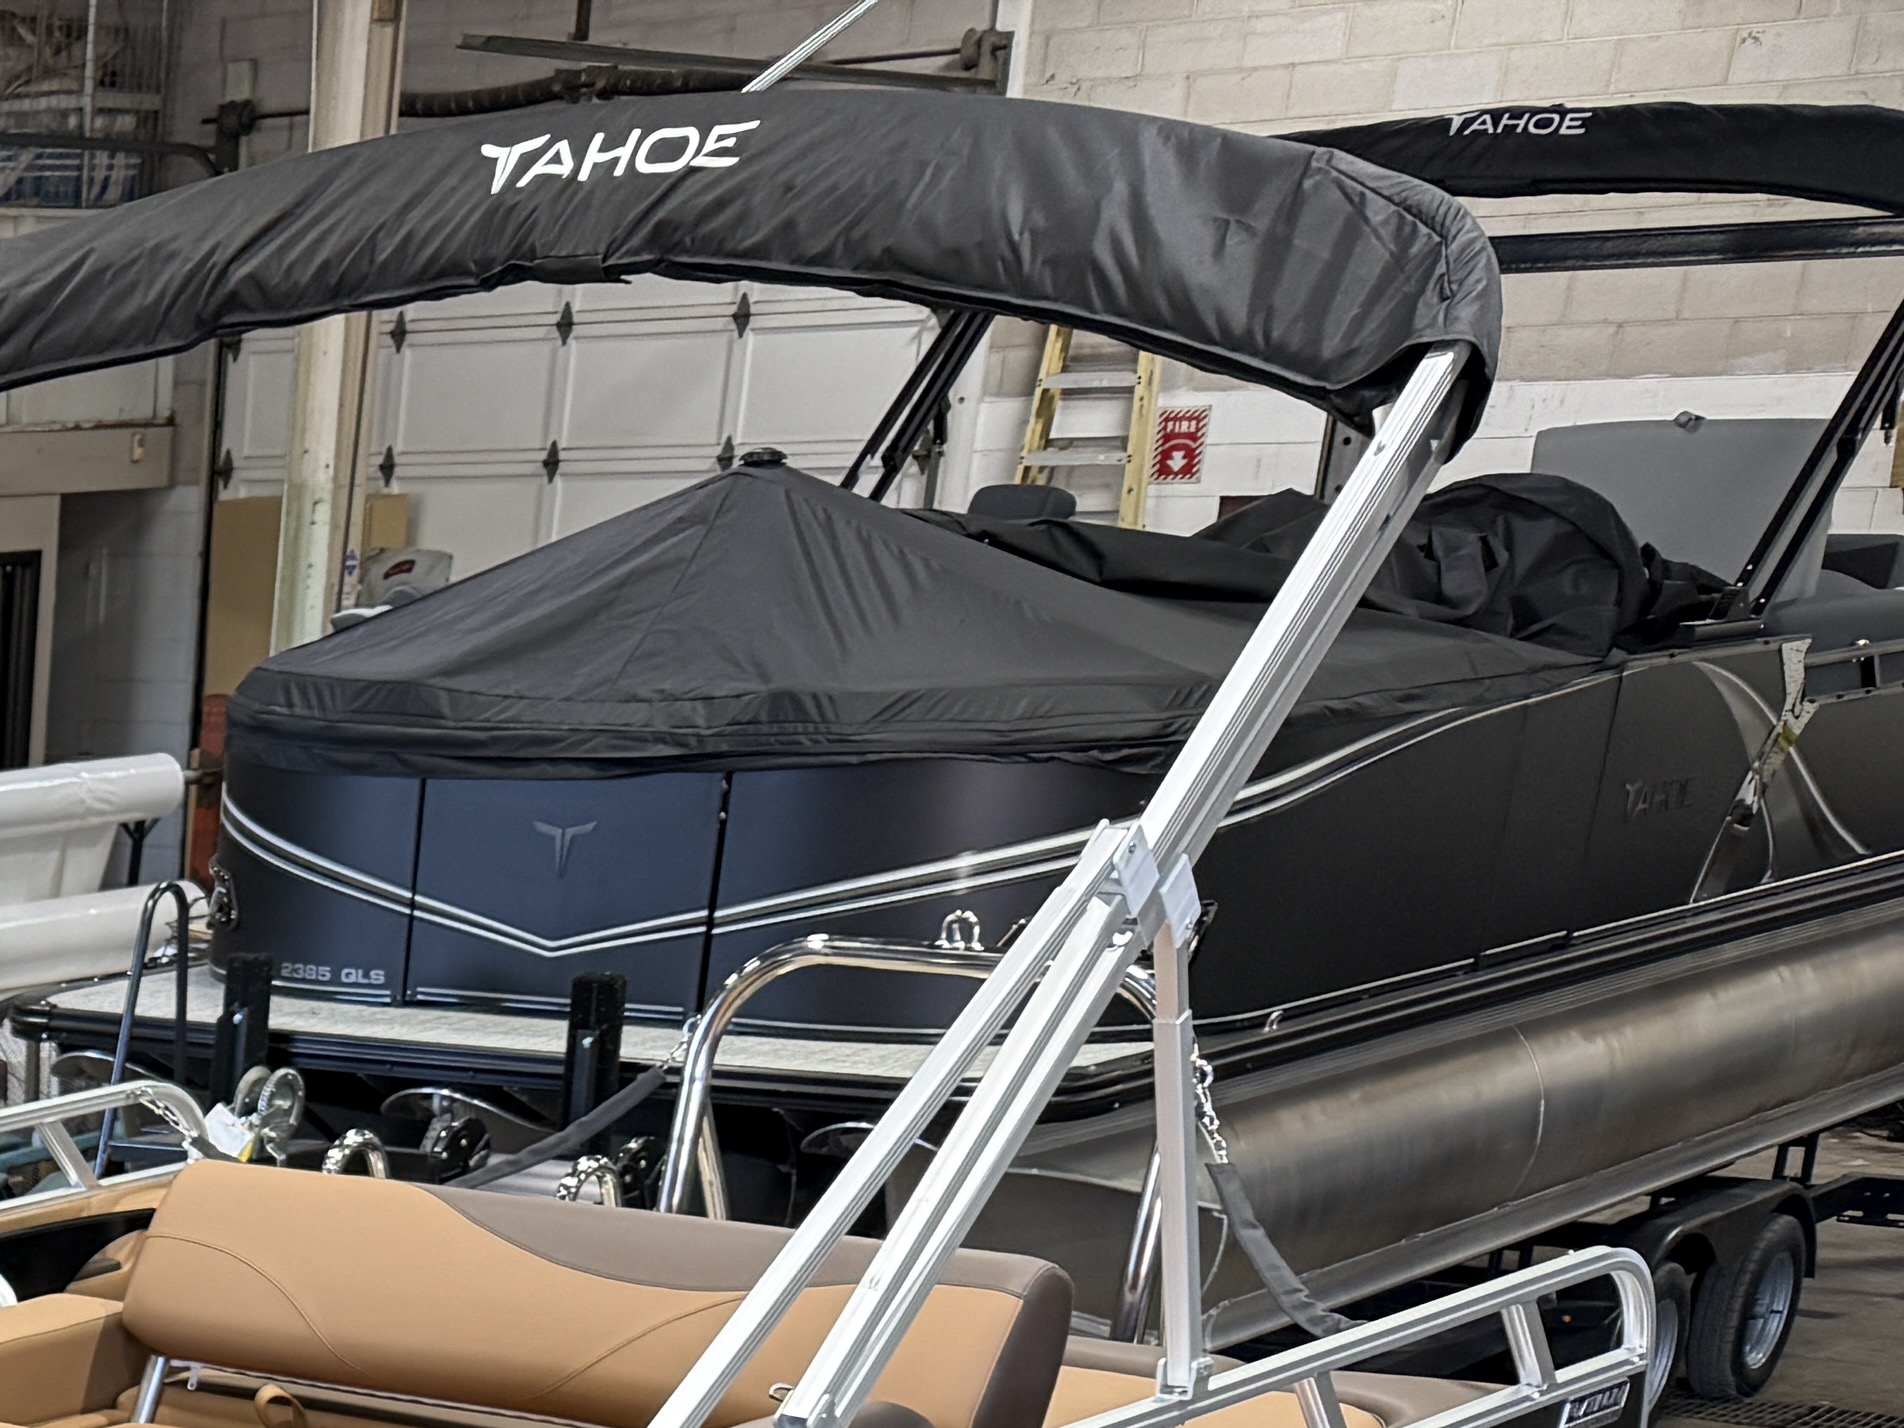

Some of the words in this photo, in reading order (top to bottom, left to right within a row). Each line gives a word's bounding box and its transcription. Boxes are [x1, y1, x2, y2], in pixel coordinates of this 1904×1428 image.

[1444, 111, 1593, 136] TAHOE
[480, 119, 762, 195] TAHOE
[1166, 419, 1198, 434] FIRE
[280, 962, 332, 981] 2385
